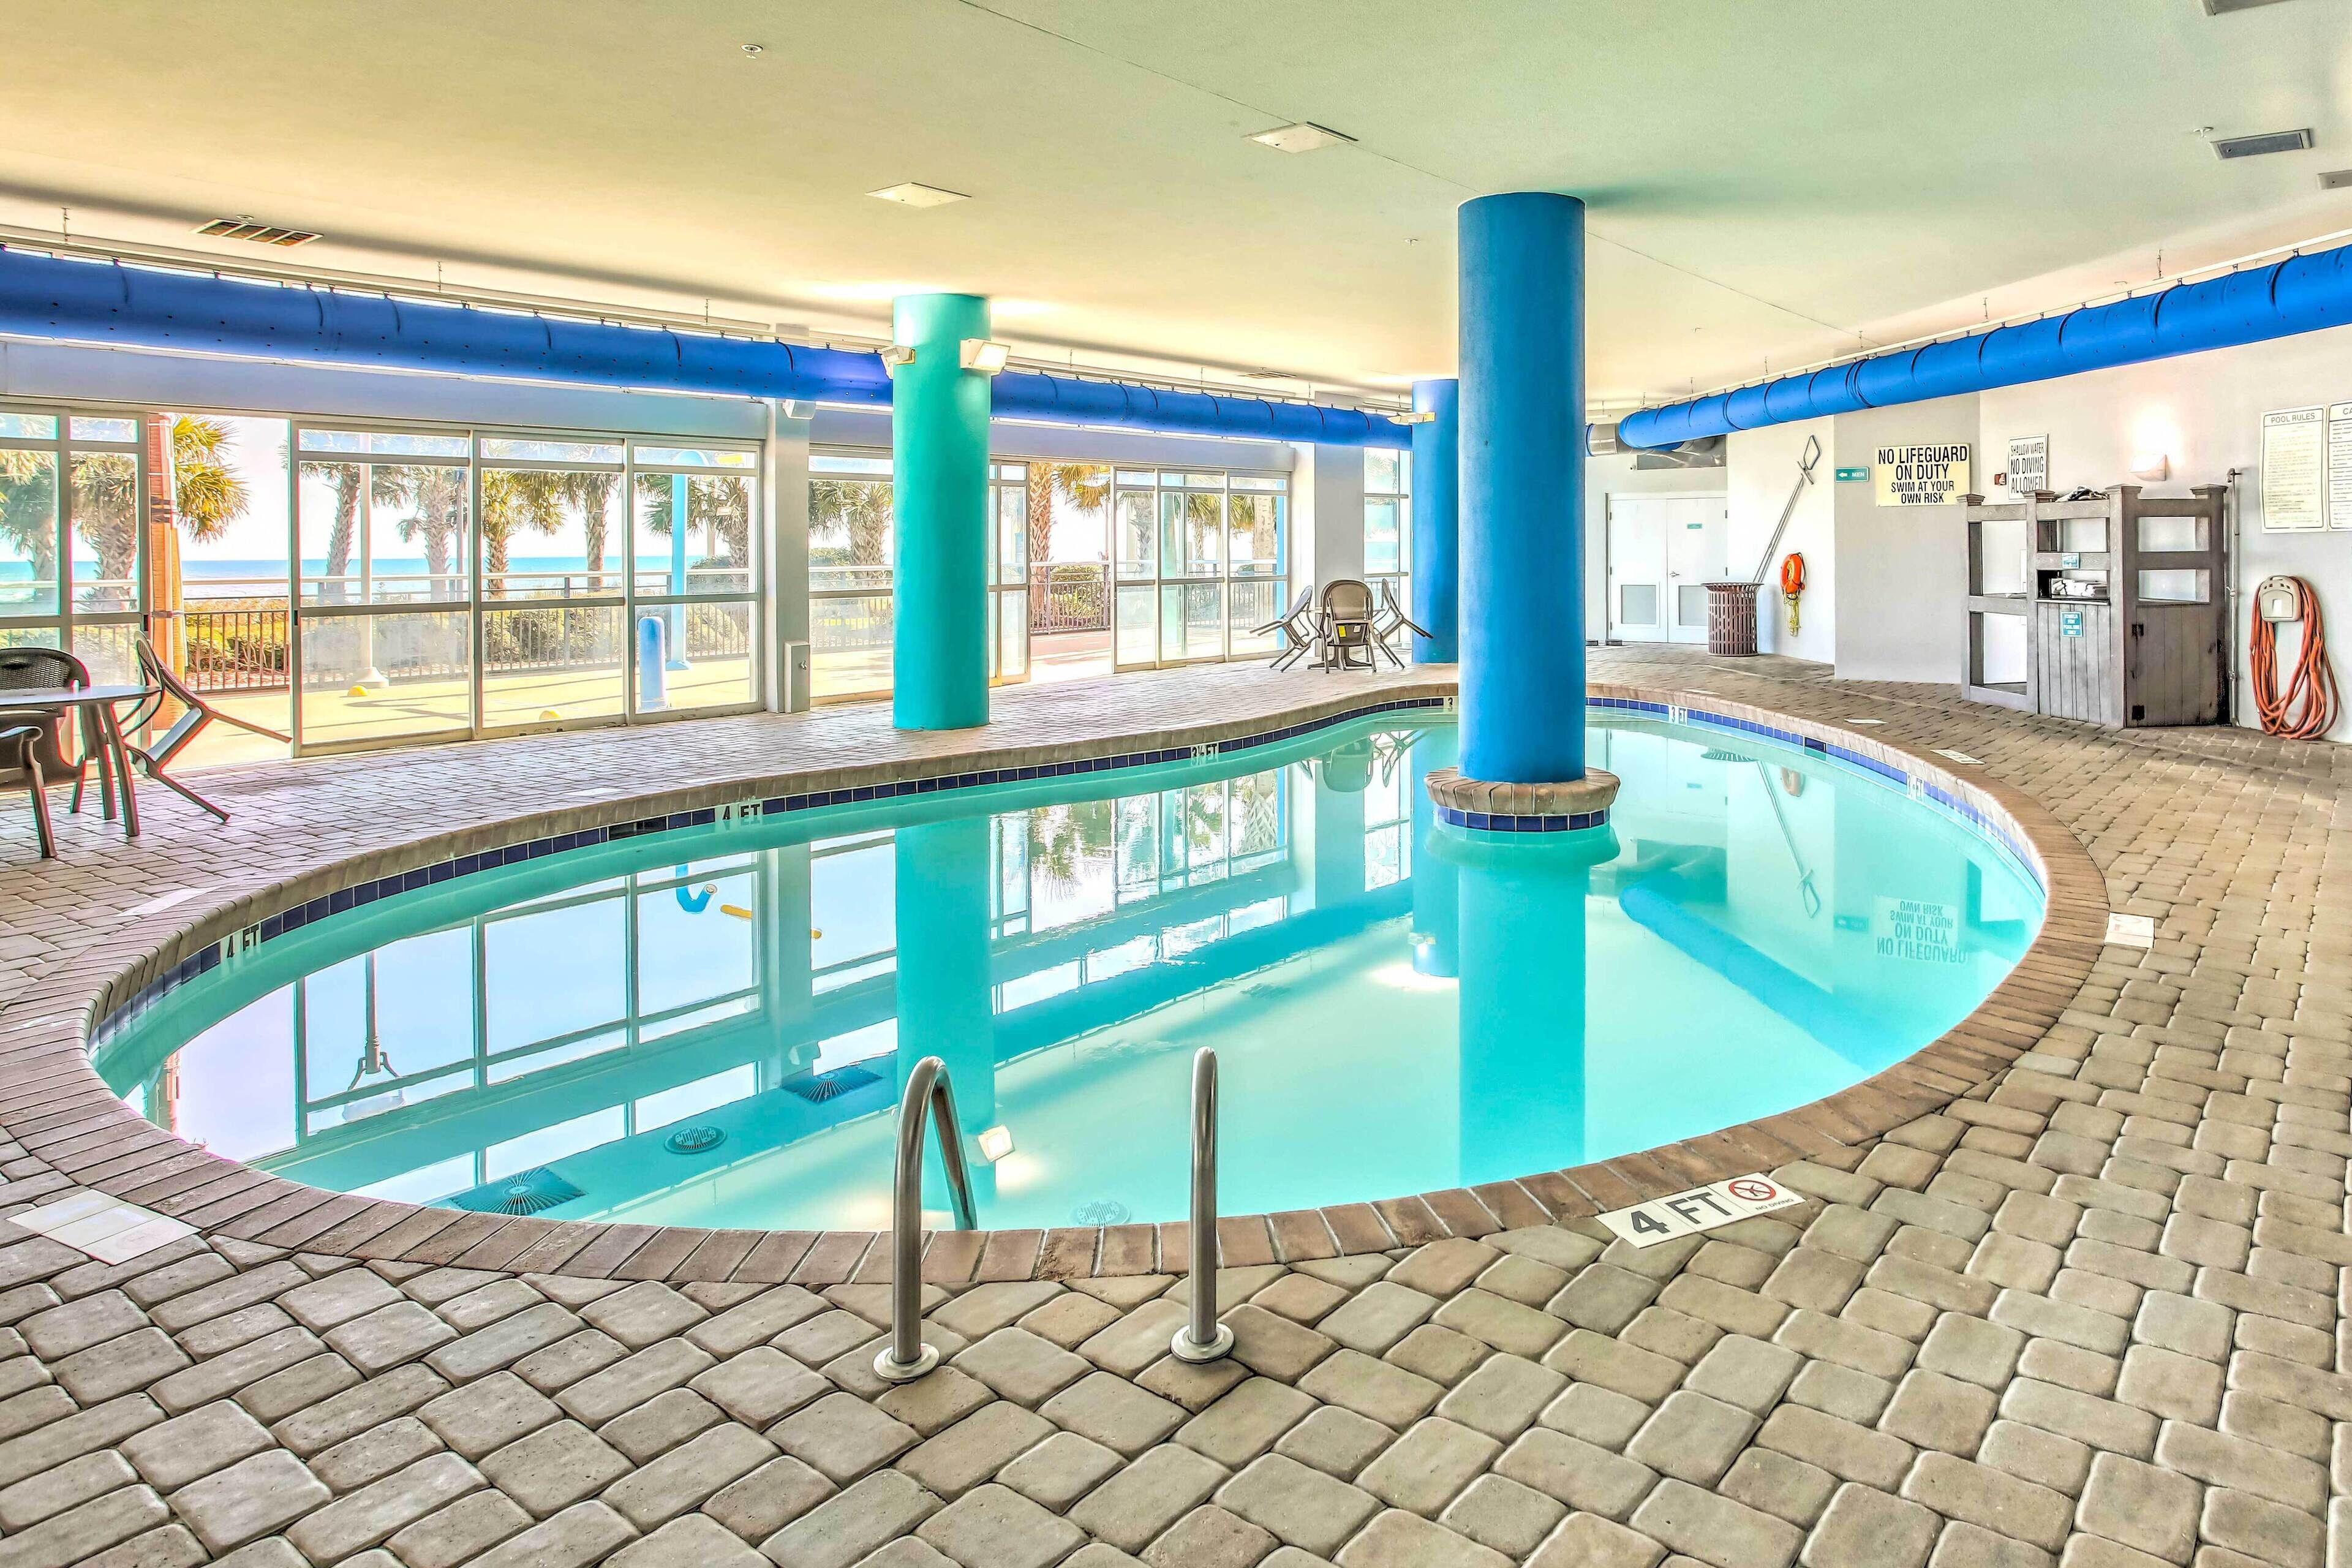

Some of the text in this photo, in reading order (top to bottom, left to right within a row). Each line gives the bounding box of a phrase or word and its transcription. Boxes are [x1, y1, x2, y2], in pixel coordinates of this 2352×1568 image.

[2292, 412, 2315, 421] RULES
[1878, 445, 1968, 464] NO LIFEGUARD
[2011, 442, 2044, 456] SHALLOW WATER
[1896, 463, 1949, 480] ON DUTY
[2010, 456, 2044, 475] NO DIVING
[1891, 480, 1954, 493] SWIM AT YOUR
[2011, 476, 2043, 494] ALLOWED
[1901, 492, 1945, 504] OWN RISK
[741, 804, 761, 817] FT
[243, 924, 260, 952] FT
[1768, 1198, 1794, 1207] DIVING
[1630, 1191, 1733, 1234] 4 FT
